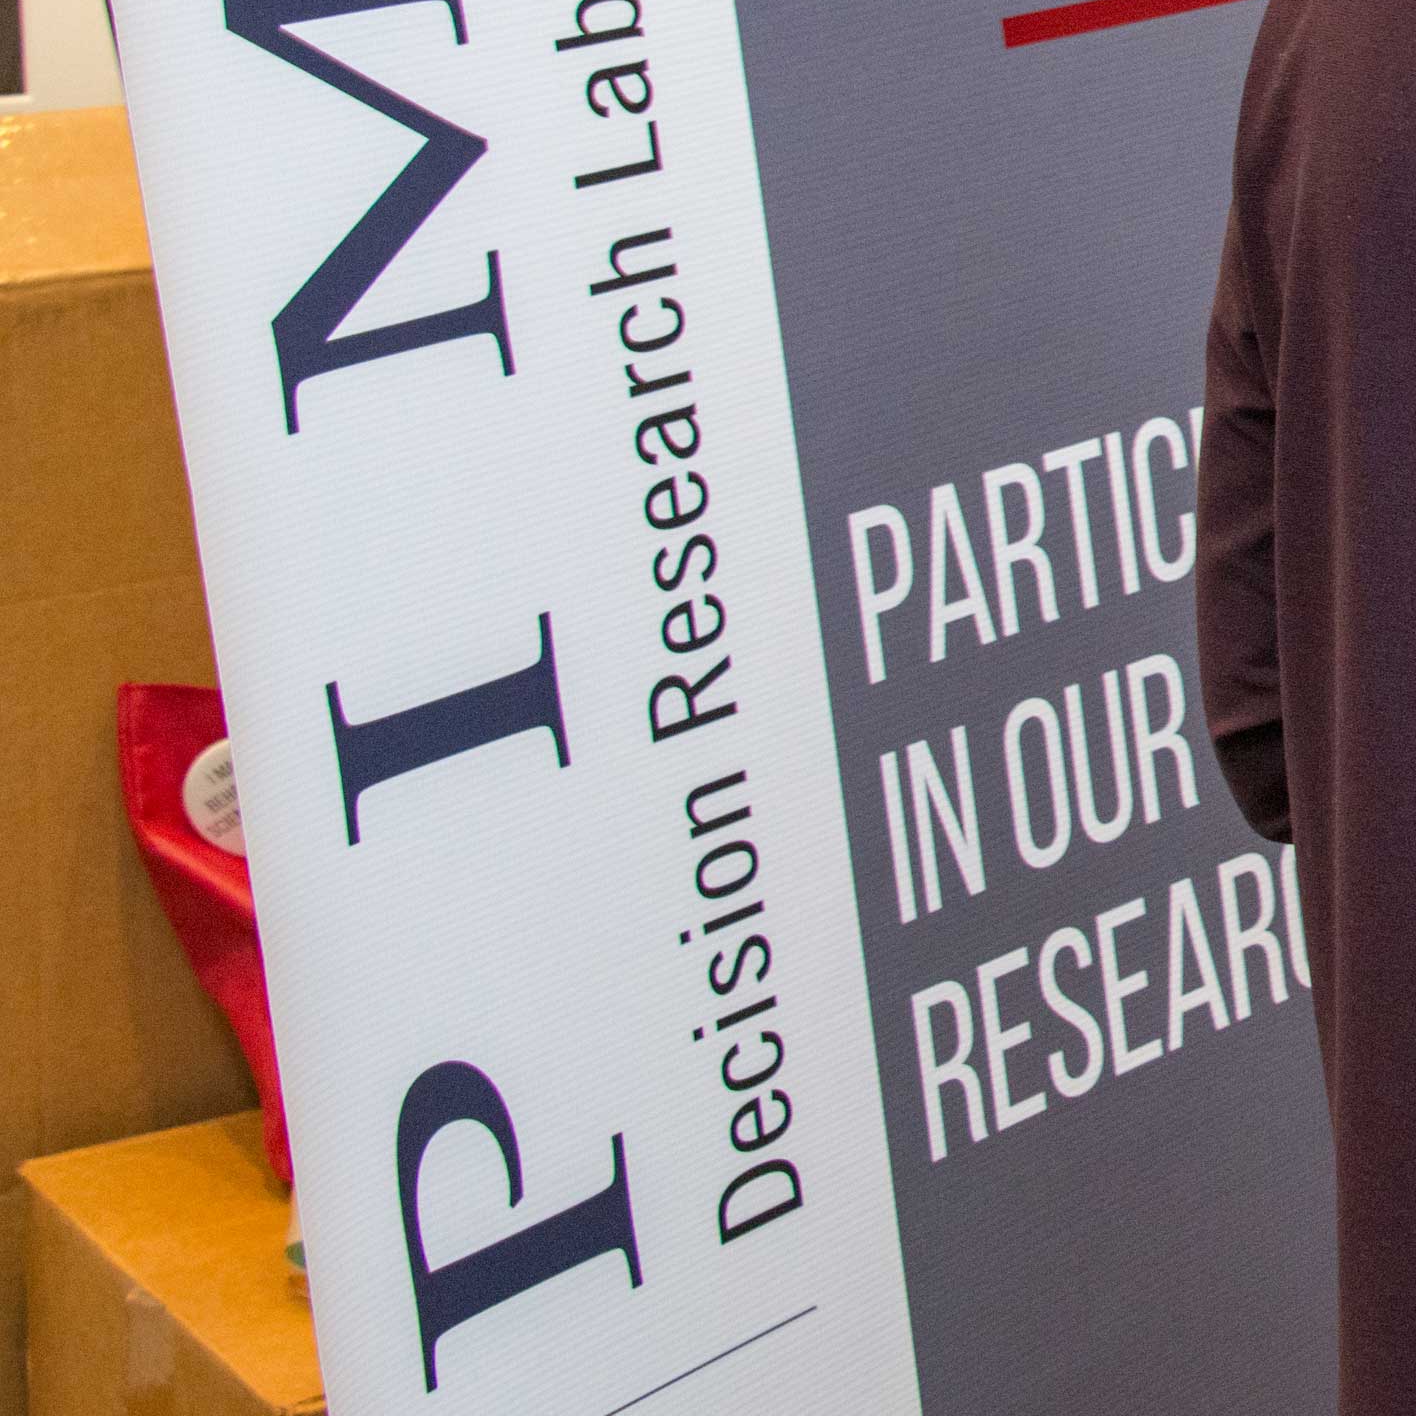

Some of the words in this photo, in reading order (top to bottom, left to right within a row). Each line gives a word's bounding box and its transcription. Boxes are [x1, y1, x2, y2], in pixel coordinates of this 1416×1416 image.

[590, 226, 739, 743] Research
[848, 406, 1204, 685] PARTIC
[879, 724, 987, 925] IN
[1004, 652, 1200, 871] OUR
[680, 770, 804, 1245] Decision
